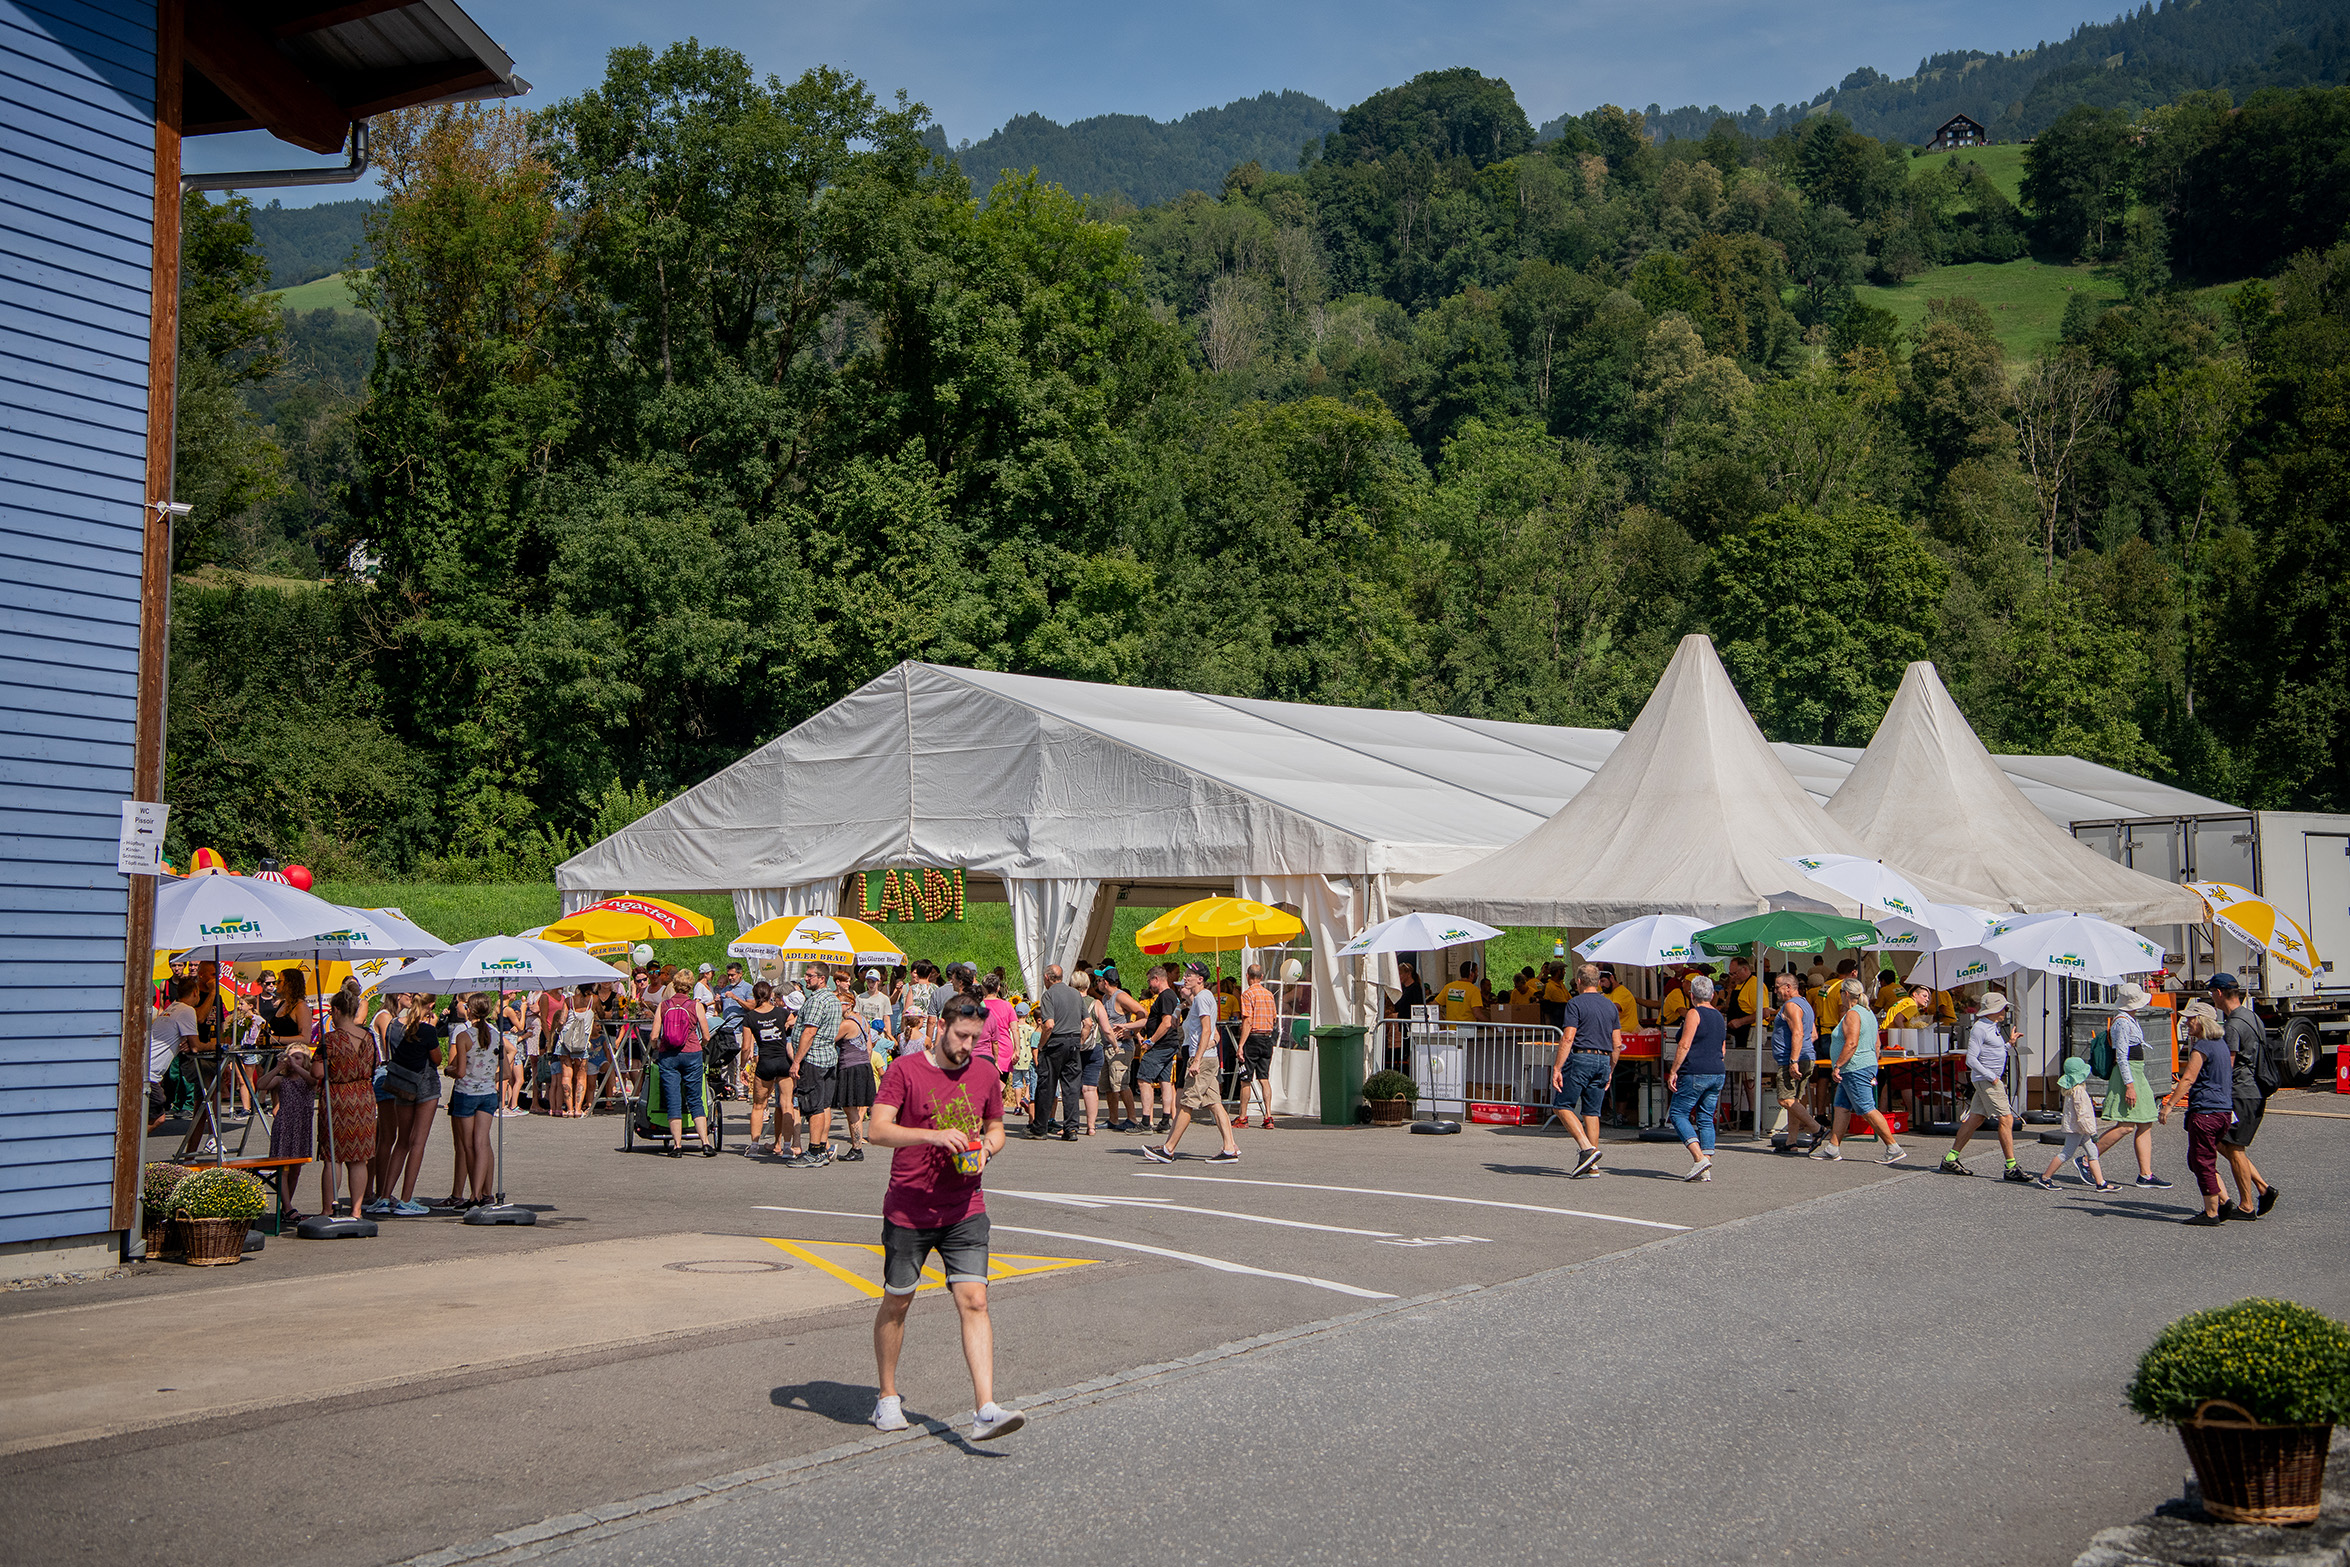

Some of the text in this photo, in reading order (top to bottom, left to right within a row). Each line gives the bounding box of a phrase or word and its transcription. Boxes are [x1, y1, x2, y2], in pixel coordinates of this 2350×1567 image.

[859, 868, 964, 922] LANDI
[1883, 896, 1914, 915] Landi
[200, 920, 261, 935] Landi
[202, 932, 263, 942] LINTH
[314, 932, 369, 941] Landi
[1438, 930, 1470, 941] Landi
[1885, 935, 1919, 944] Landi
[1779, 940, 1808, 948] FARMER
[785, 952, 846, 962] ADLER BRÄU
[1660, 948, 1695, 958] Landi
[481, 960, 532, 970] Landi
[2049, 955, 2085, 968] Landi
[1956, 963, 1988, 978] Landi
[1956, 972, 1988, 983] LINTH
